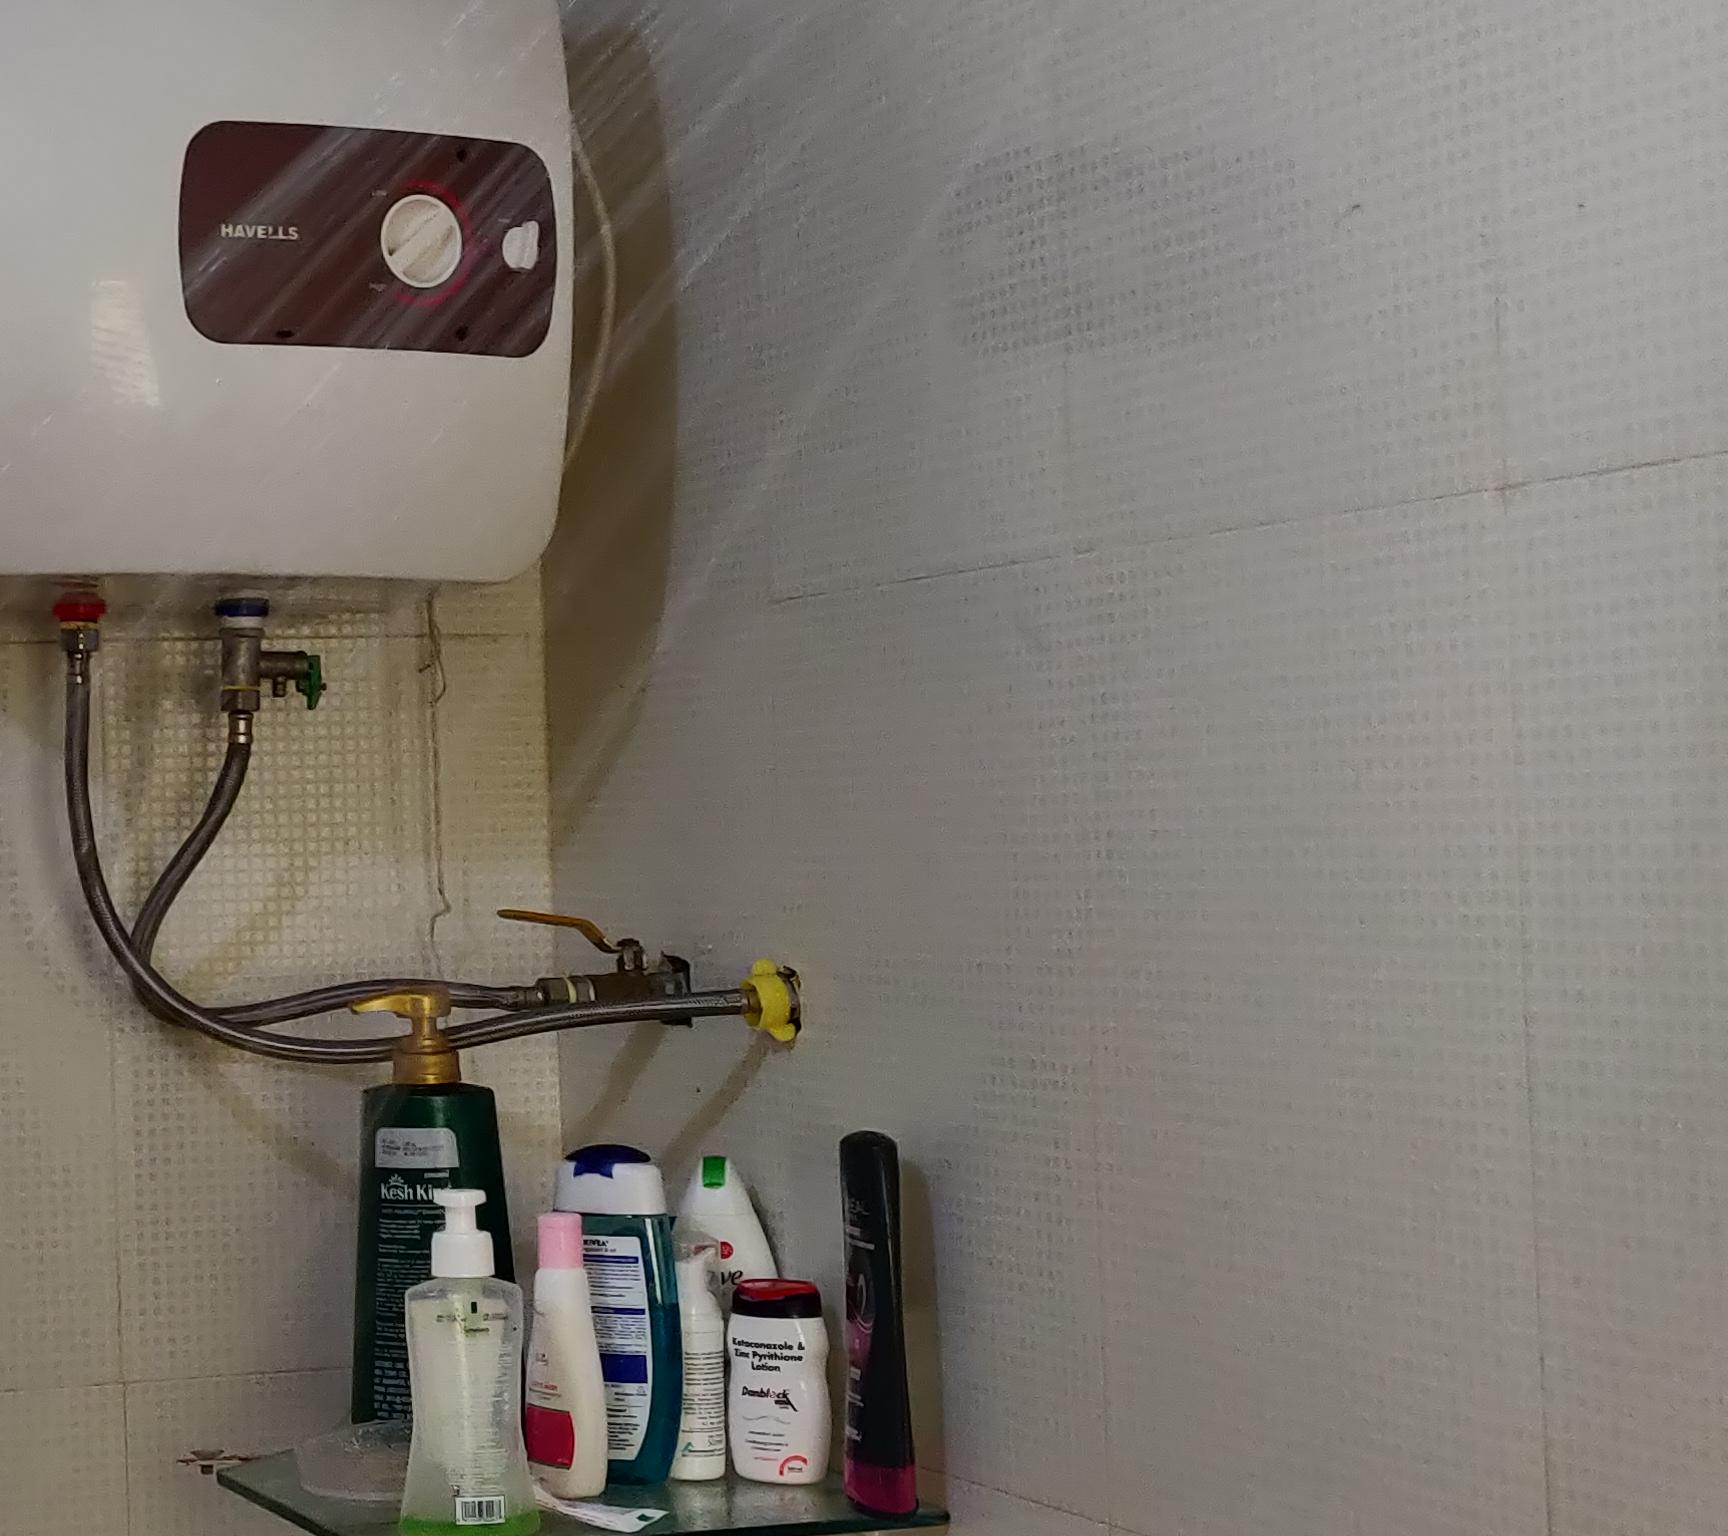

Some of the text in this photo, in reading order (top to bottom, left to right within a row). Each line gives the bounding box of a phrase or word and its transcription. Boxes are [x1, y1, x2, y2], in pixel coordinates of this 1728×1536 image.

[221, 224, 298, 240] HAVELLS
[381, 1183, 434, 1200] Kesh Ki
[732, 1337, 793, 1351] Ketoconazole
[752, 1350, 803, 1362] Pyrithione
[751, 1361, 781, 1372] Lotion
